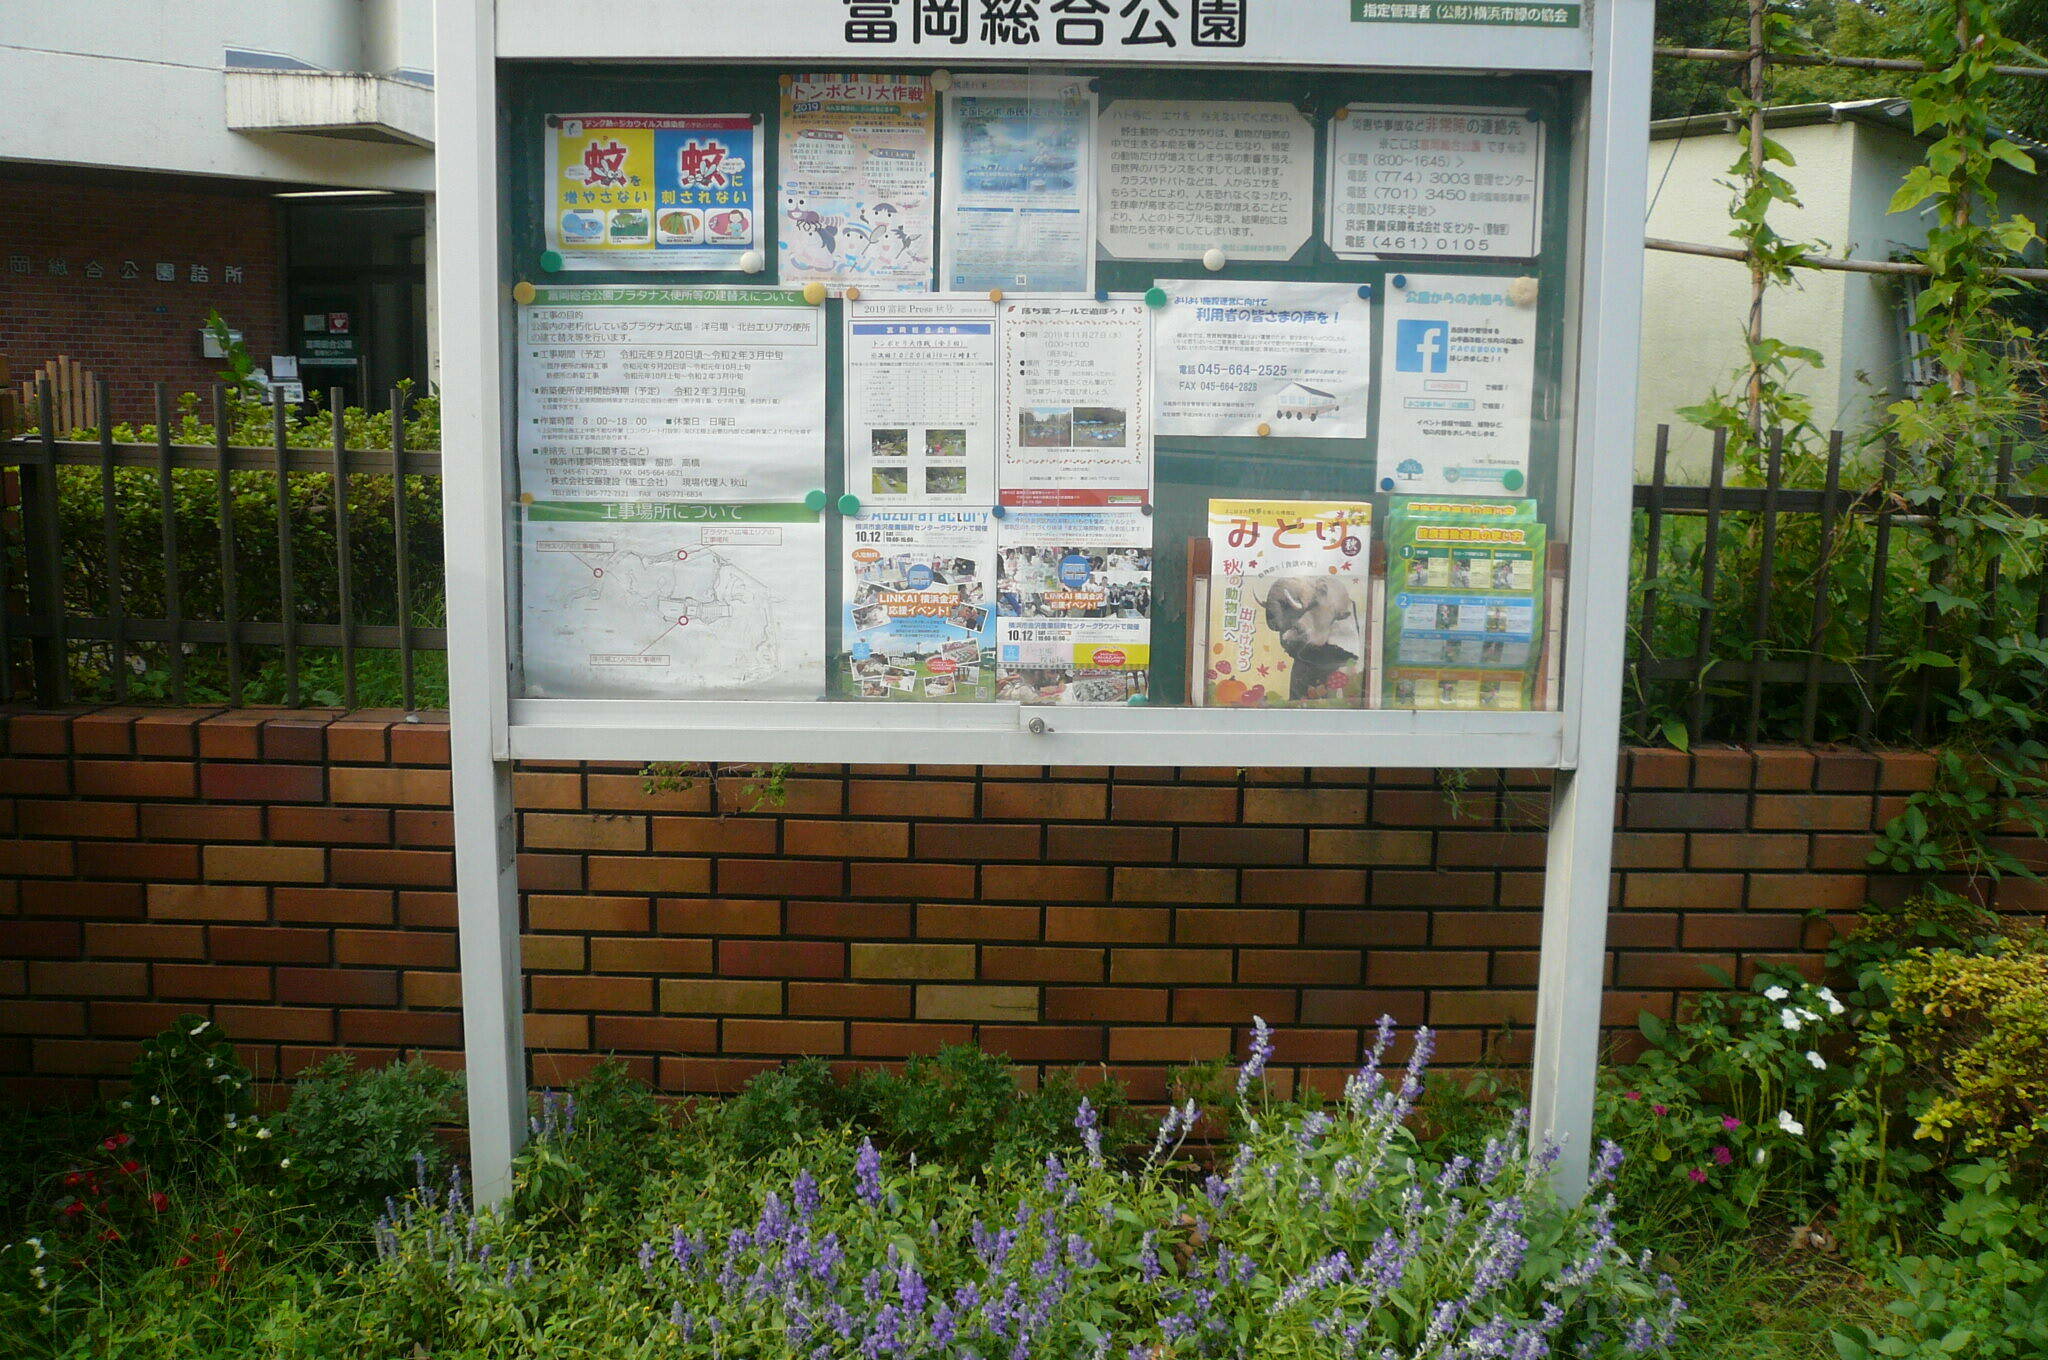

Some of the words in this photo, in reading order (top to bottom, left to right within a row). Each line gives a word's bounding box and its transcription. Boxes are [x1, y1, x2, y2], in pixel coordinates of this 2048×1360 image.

[844, 0, 1246, 47] 富岡総合公園
[795, 85, 923, 101] トンボとり大作戦
[795, 102, 819, 112] 2019
[1347, 170, 1367, 182] 電話
[1430, 172, 1470, 184] 3003
[563, 190, 648, 204] 増やさない
[661, 191, 747, 204] 刺されない
[1346, 186, 1367, 199] 電話
[1425, 188, 1466, 200] 3450
[1344, 236, 1366, 248] 電話
[1436, 238, 1490, 250] 0105
[864, 305, 885, 314] 2019
[909, 304, 933, 314] Press
[1197, 308, 1340, 324] 利用者の皆さまの声を！
[1179, 364, 1196, 375] 電話
[1198, 364, 1287, 376] 045-664-2525
[1179, 382, 1196, 391] FAX
[1200, 382, 1258, 392] 045-664-2828
[540, 416, 574, 426] 作業時間
[674, 417, 700, 426] 休業日
[709, 417, 736, 426] 日曜日
[601, 504, 744, 520] 工事場所について
[856, 532, 880, 542] 10.12
[1228, 518, 1348, 550] みどり
[1345, 538, 1356, 551] 秋
[1222, 558, 1241, 642] 秋の動物園へ
[1400, 596, 1407, 606] 2
[1008, 630, 1032, 641] 10.12
[1238, 608, 1255, 672] 出かけよう
